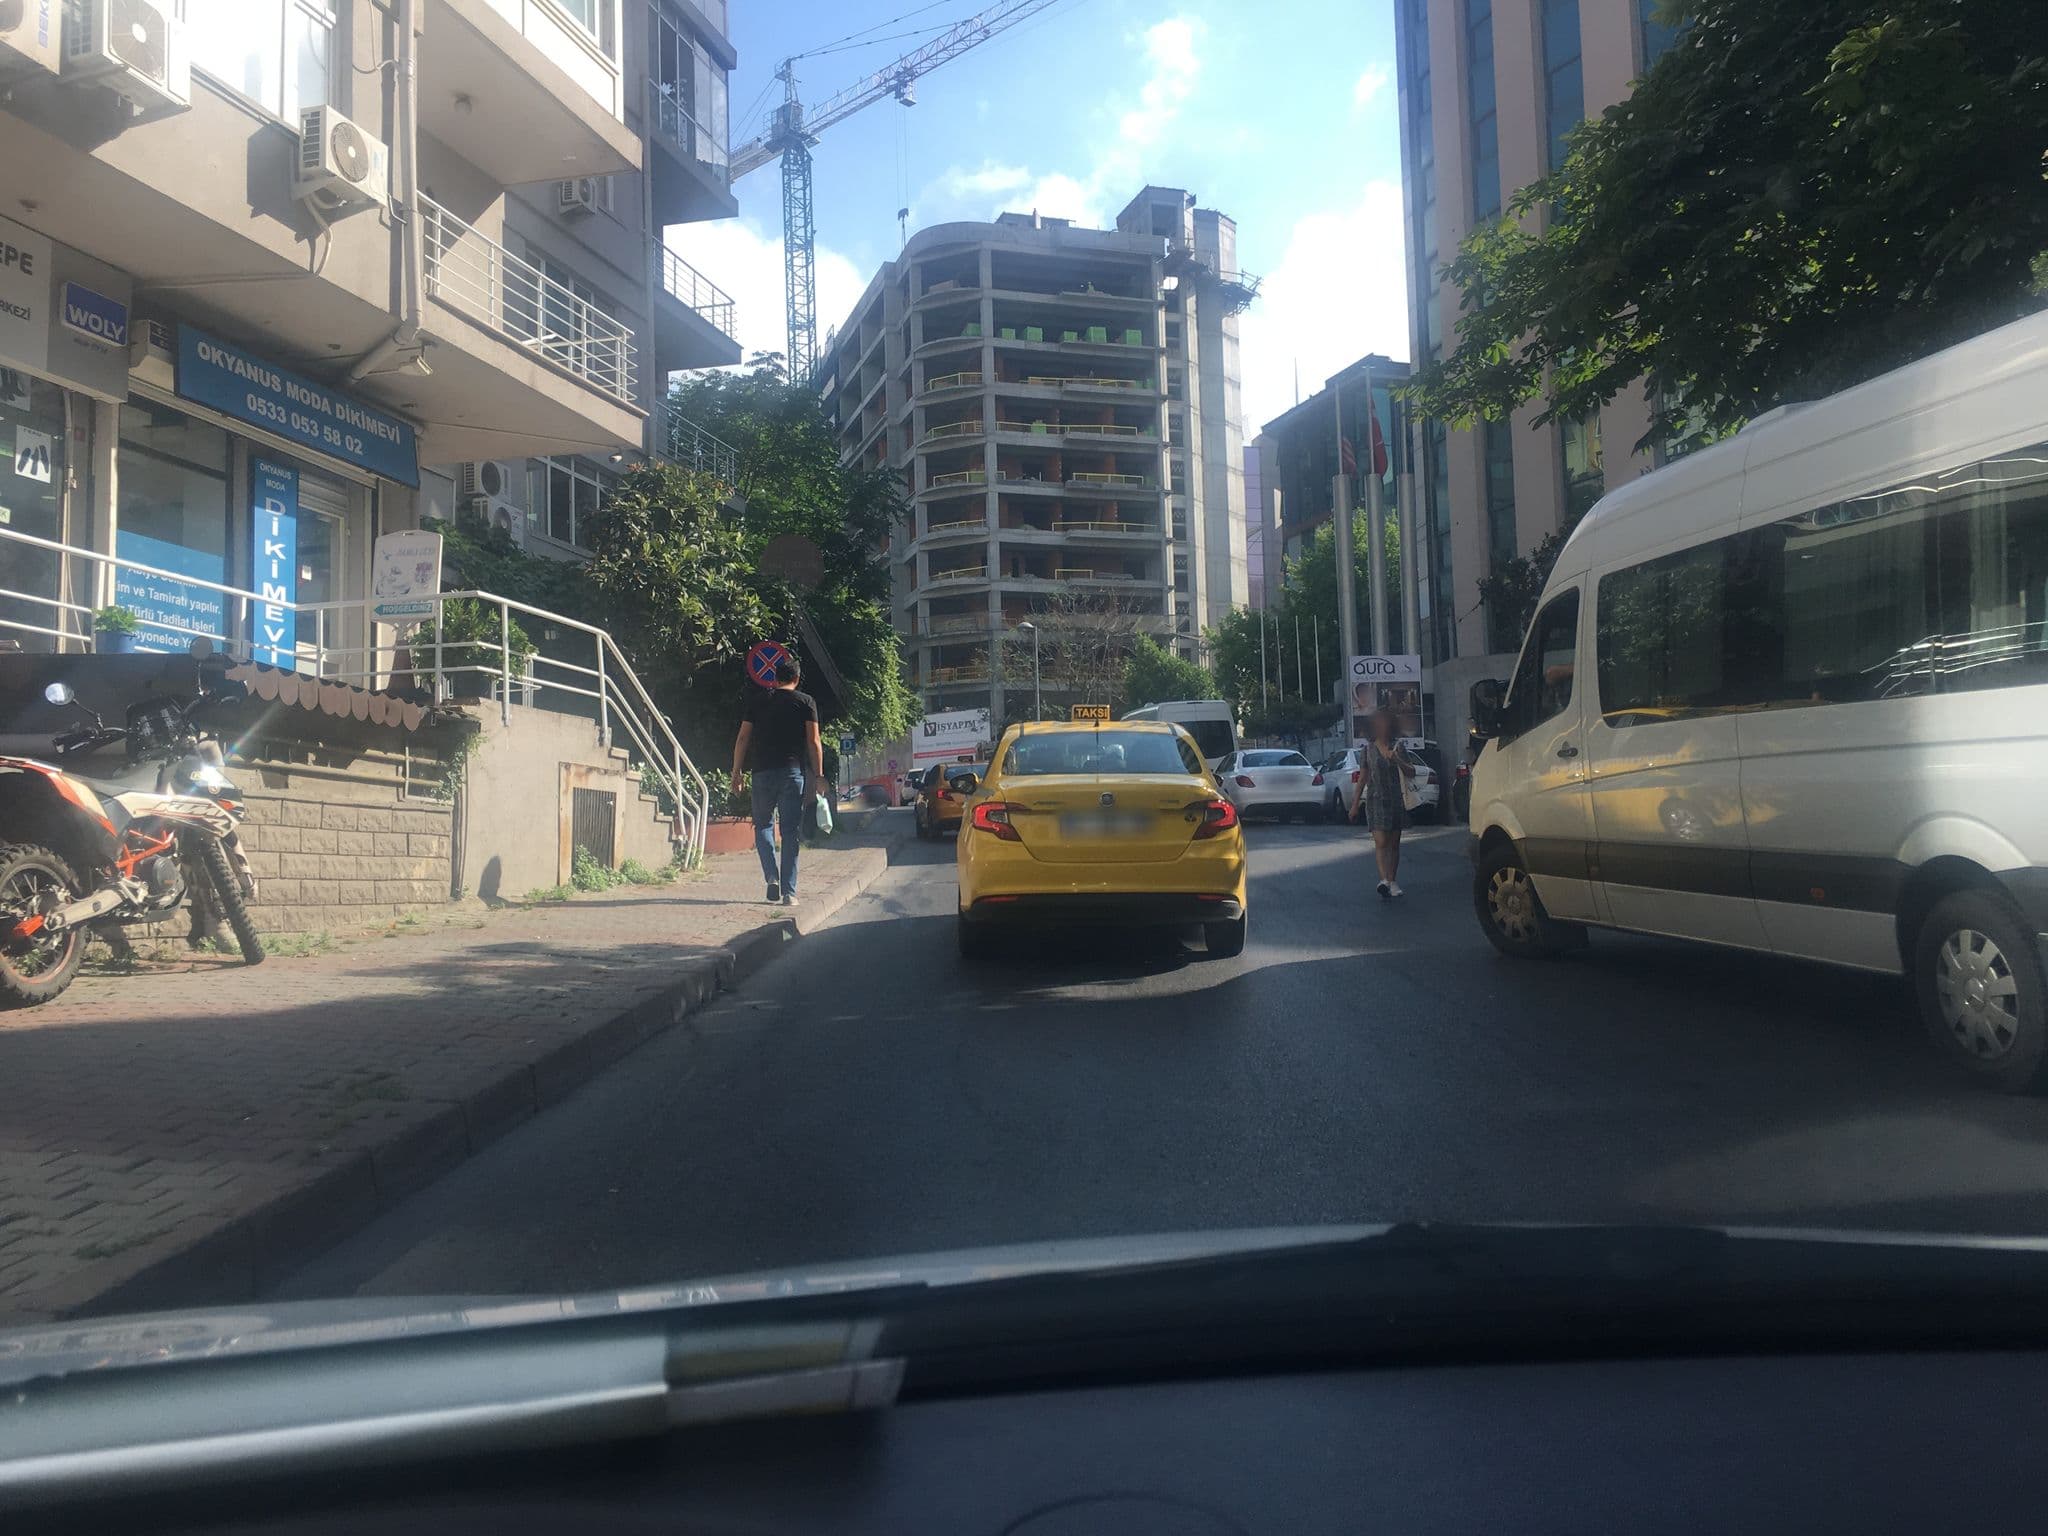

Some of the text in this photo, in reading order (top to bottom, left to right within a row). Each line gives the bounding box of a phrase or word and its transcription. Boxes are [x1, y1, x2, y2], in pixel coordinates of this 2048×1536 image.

[67, 303, 124, 341] WOLY
[197, 341, 401, 445] OKYANUS MODA DİKİMEVİ
[246, 393, 363, 455] 0533 053 58 02
[260, 462, 292, 480] OKYANUS
[265, 479, 286, 491] MODA
[133, 586, 145, 597] ve
[157, 610, 190, 629] Tadilat
[192, 615, 215, 633] İşleri
[1353, 660, 1395, 674] aura
